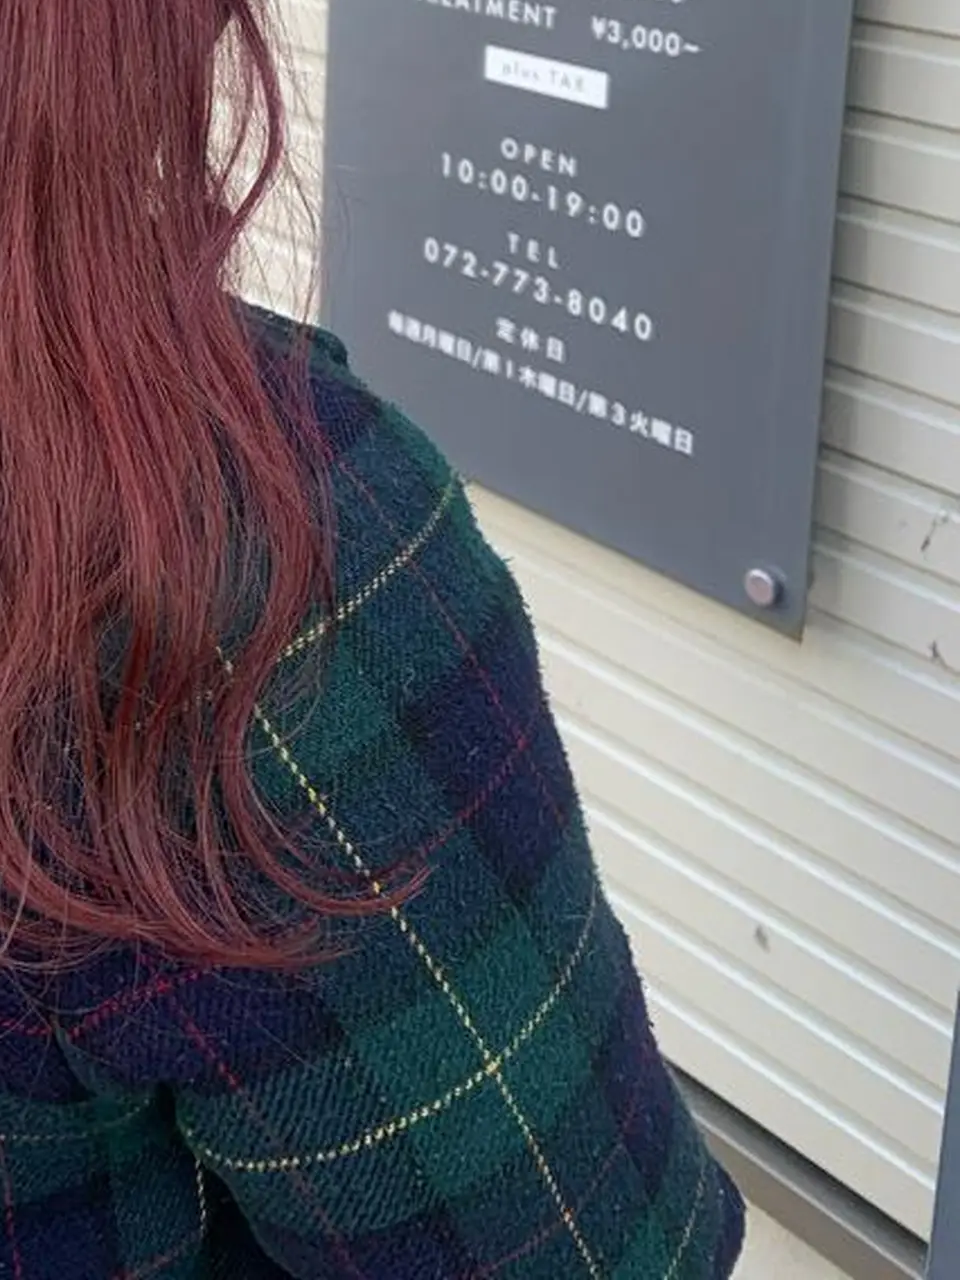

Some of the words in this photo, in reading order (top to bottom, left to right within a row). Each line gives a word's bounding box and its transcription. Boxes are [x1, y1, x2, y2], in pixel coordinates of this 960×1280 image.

[500, 137, 578, 178] OPEN
[441, 151, 646, 239] 10:00-19:00
[506, 232, 560, 270] TEL
[423, 236, 653, 342] 072-773-8040
[495, 317, 566, 363] 定休日
